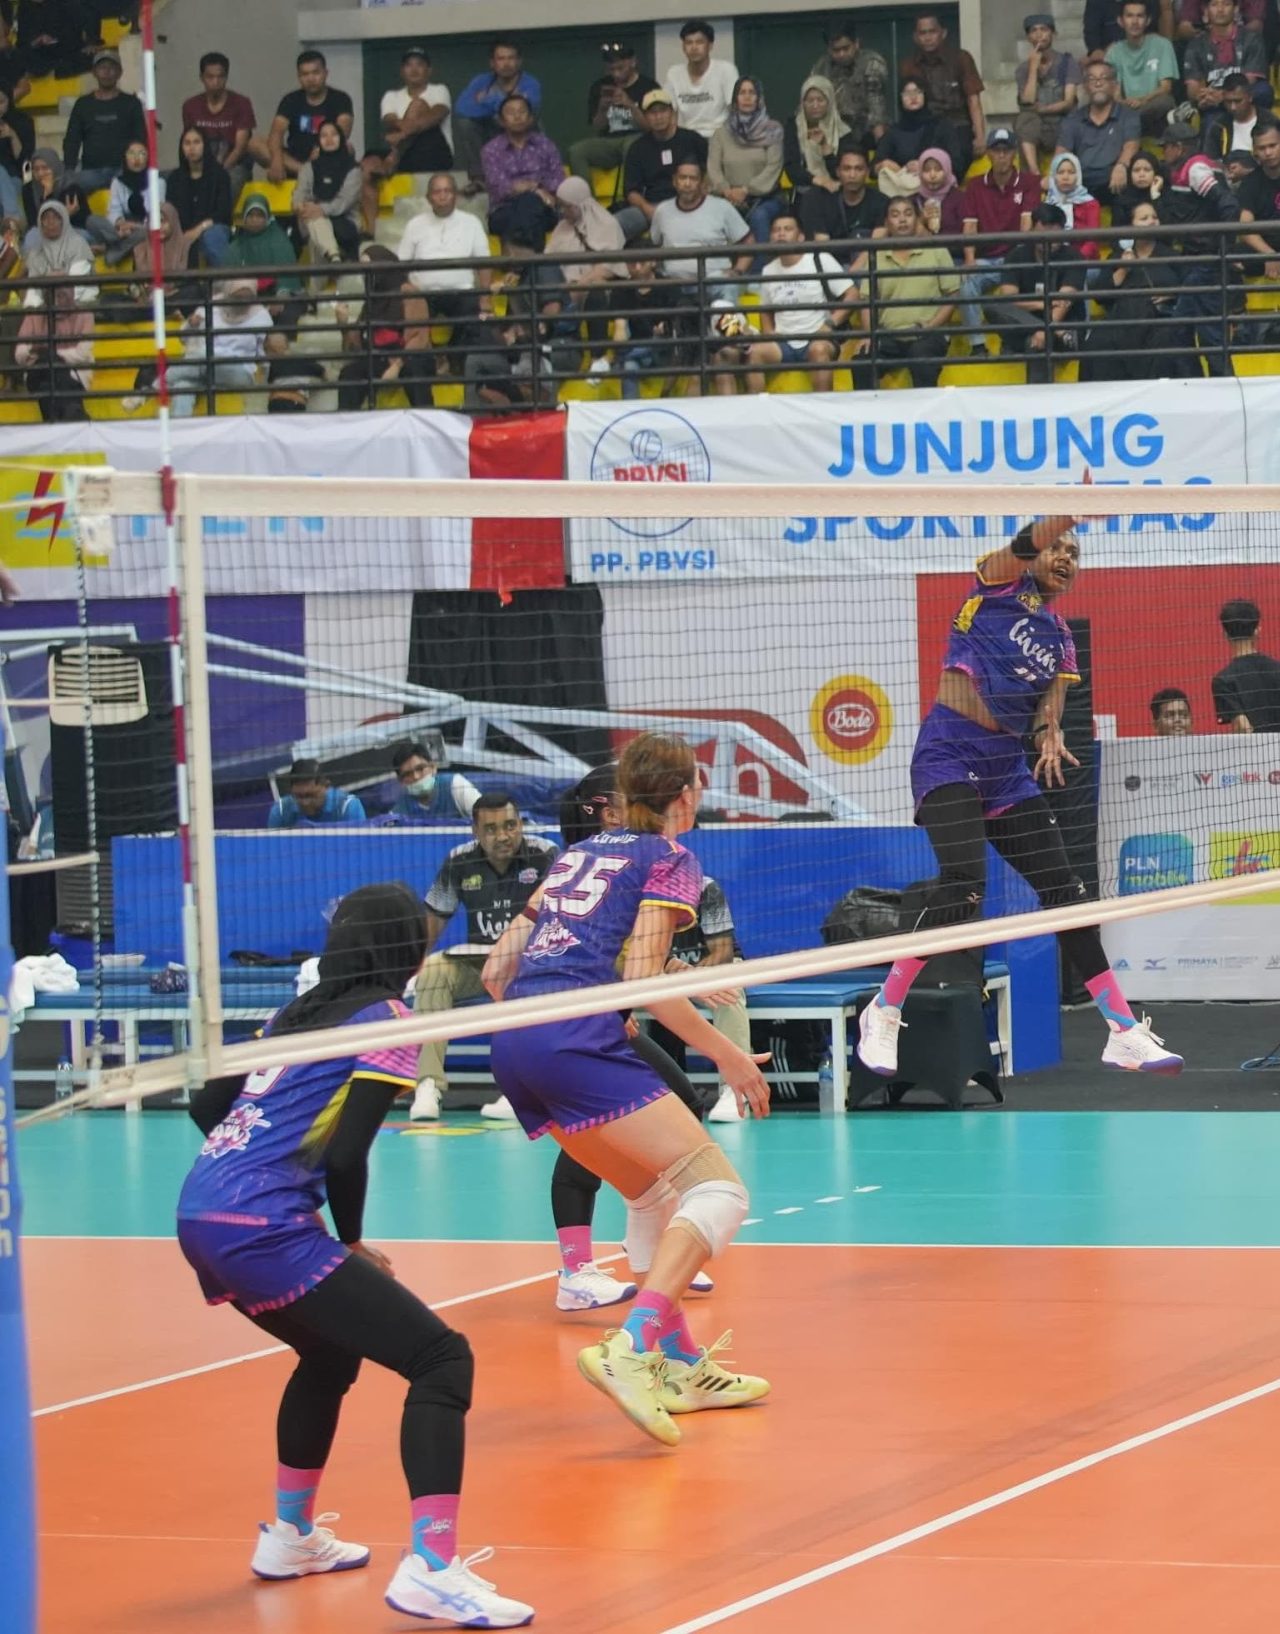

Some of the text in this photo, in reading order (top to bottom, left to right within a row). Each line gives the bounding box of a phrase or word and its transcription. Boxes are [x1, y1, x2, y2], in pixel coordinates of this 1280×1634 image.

[828, 413, 1164, 477] JUNJUNG
[591, 550, 715, 573] PP. PBVSI
[543, 850, 632, 918] 25
[1125, 855, 1161, 871] PLN
